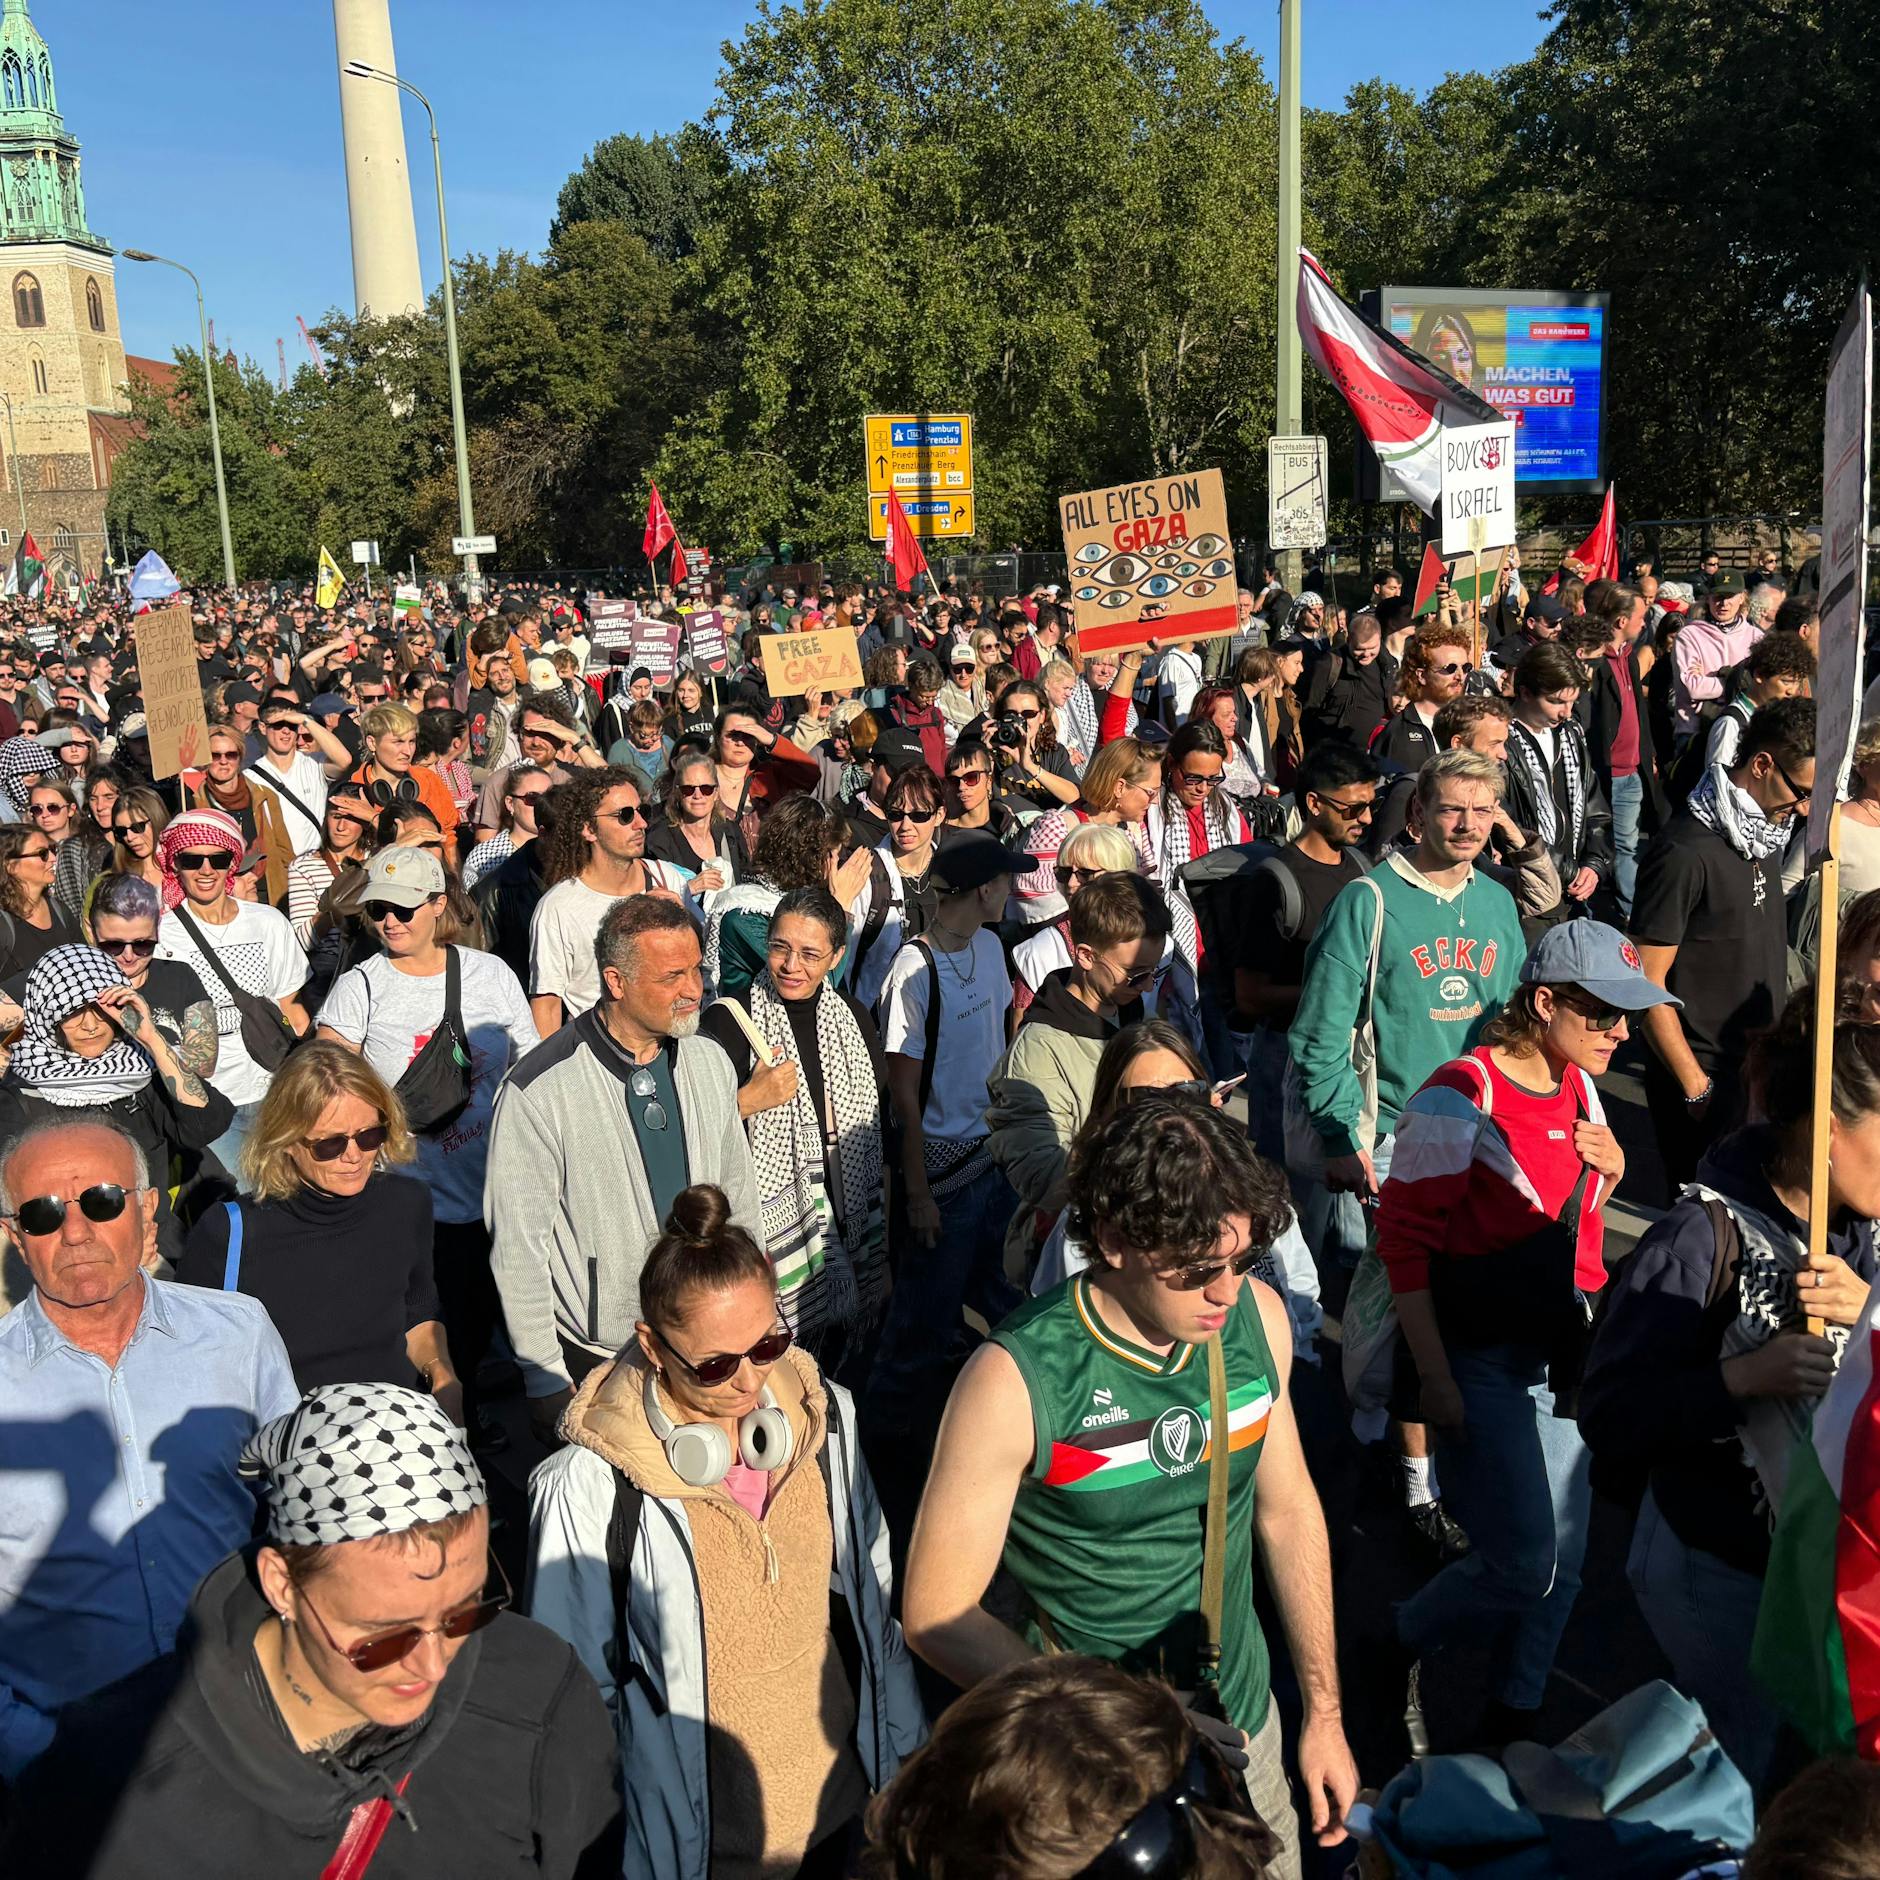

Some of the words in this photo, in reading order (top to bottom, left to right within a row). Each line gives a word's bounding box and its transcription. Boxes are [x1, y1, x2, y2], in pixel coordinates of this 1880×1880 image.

[1486, 366, 1575, 384] MACHEN,
[1485, 388, 1530, 403] WAS
[1536, 388, 1573, 403] GUT
[925, 424, 960, 435] Hamburg
[925, 435, 959, 444] Prenzlau
[891, 450, 946, 459] Friedrichshain
[892, 461, 934, 470] Prenzlauer
[937, 460, 956, 470] Berg
[1289, 456, 1309, 468] BUS
[895, 474, 938, 485] Alexanderplatz
[916, 504, 949, 513] Dresden
[1064, 496, 1100, 532] ALL
[1106, 485, 1160, 523] EYES
[1167, 478, 1201, 512] ON
[1450, 485, 1503, 520] ISRAEL
[1113, 512, 1188, 554] GAZA
[137, 608, 191, 640] GERMAN
[138, 634, 197, 666] RESEARCH
[776, 636, 822, 661] FREE
[783, 652, 858, 686] GAZA
[149, 664, 199, 699] SUPPORTS
[148, 697, 204, 734] GENOCIDE
[1430, 1001, 1482, 1021] unlimited
[1082, 1406, 1130, 1428] o'neills
